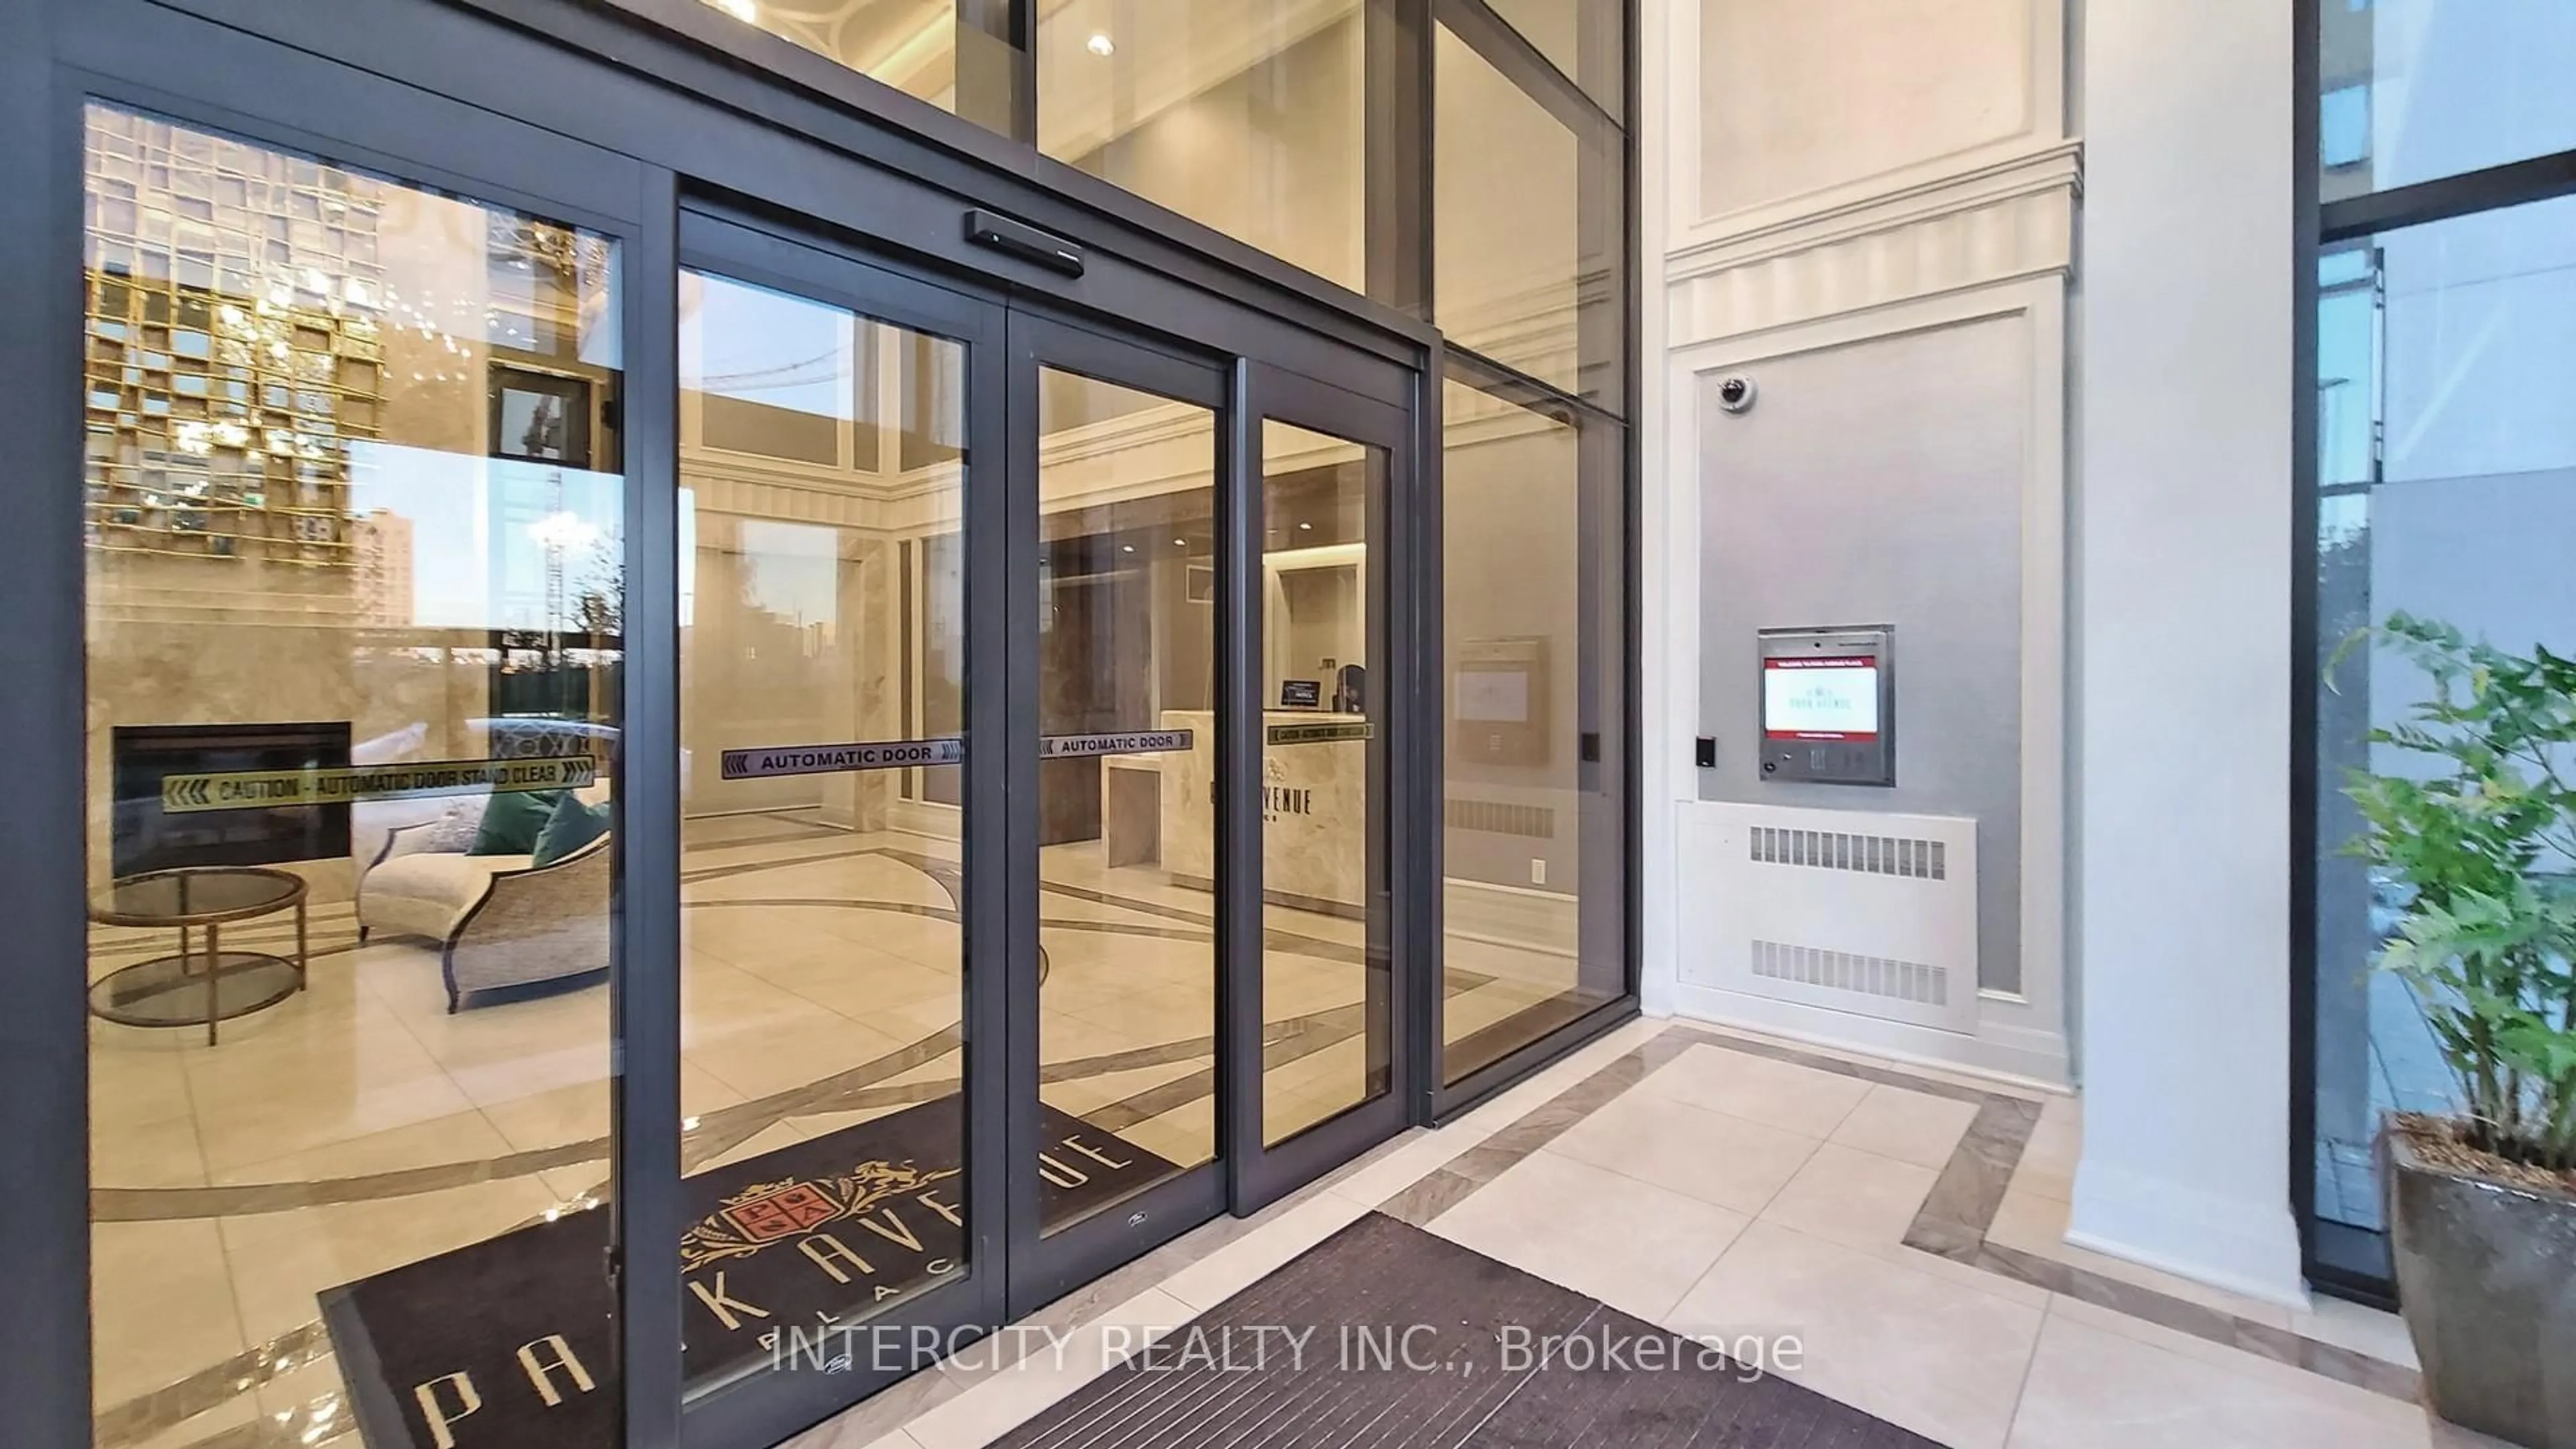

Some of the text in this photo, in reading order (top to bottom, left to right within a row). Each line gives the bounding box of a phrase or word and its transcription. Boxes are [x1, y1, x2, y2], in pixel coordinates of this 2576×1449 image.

[761, 747, 932, 770] AUTOMATIC DOOR
[1062, 735, 1173, 753] AUTOMATIC DOOR
[219, 778, 299, 800] CAUTION
[317, 773, 410, 794] AUTOMATIC
[414, 770, 458, 788] DOOR
[462, 767, 508, 786] STAND
[513, 765, 556, 784] CLEAR
[1263, 786, 1311, 815] VENUE
[756, 1258, 955, 1351] PLAC
